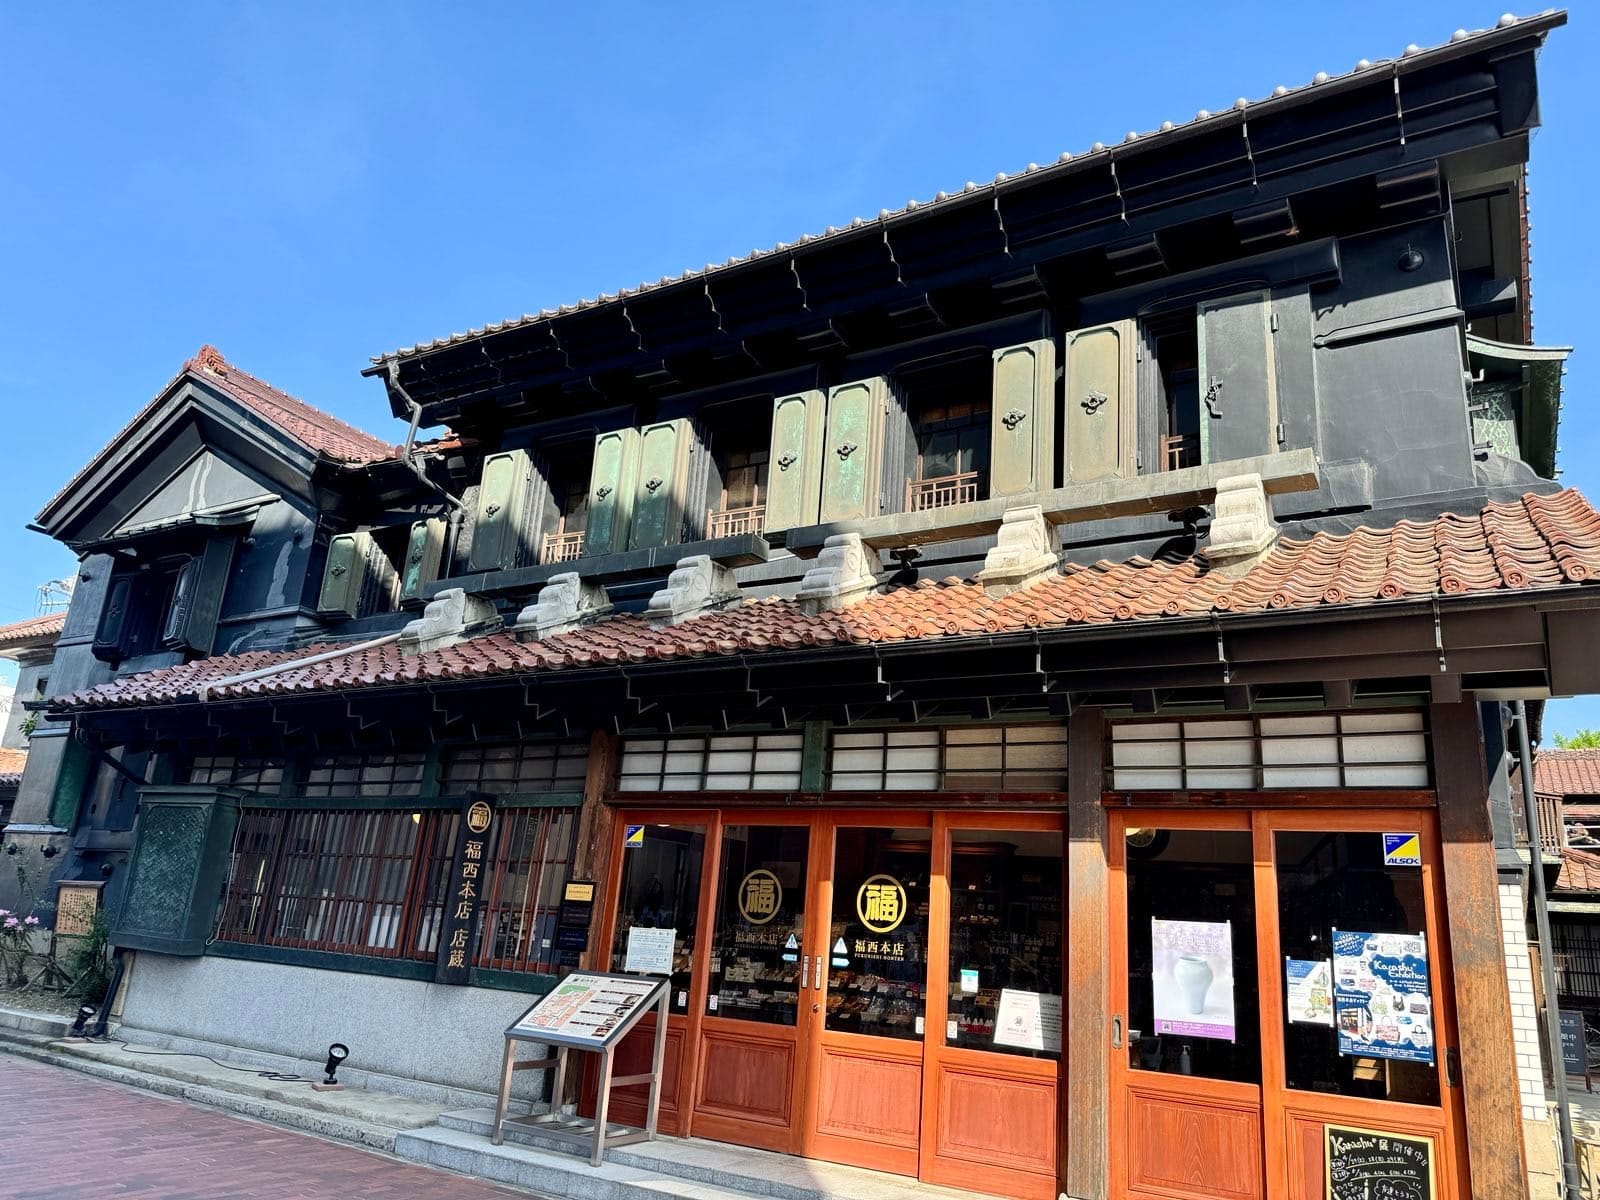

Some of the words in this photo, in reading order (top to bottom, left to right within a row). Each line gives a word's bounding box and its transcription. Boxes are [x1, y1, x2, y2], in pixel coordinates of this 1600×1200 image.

[454, 839, 484, 920] 福西本店
[1386, 857, 1420, 865] ALSOK
[743, 876, 777, 917] 福
[863, 882, 901, 924] 福
[447, 928, 469, 968] 店蔵
[855, 939, 905, 956] 福西本店
[1388, 969, 1426, 980] Exhibition
